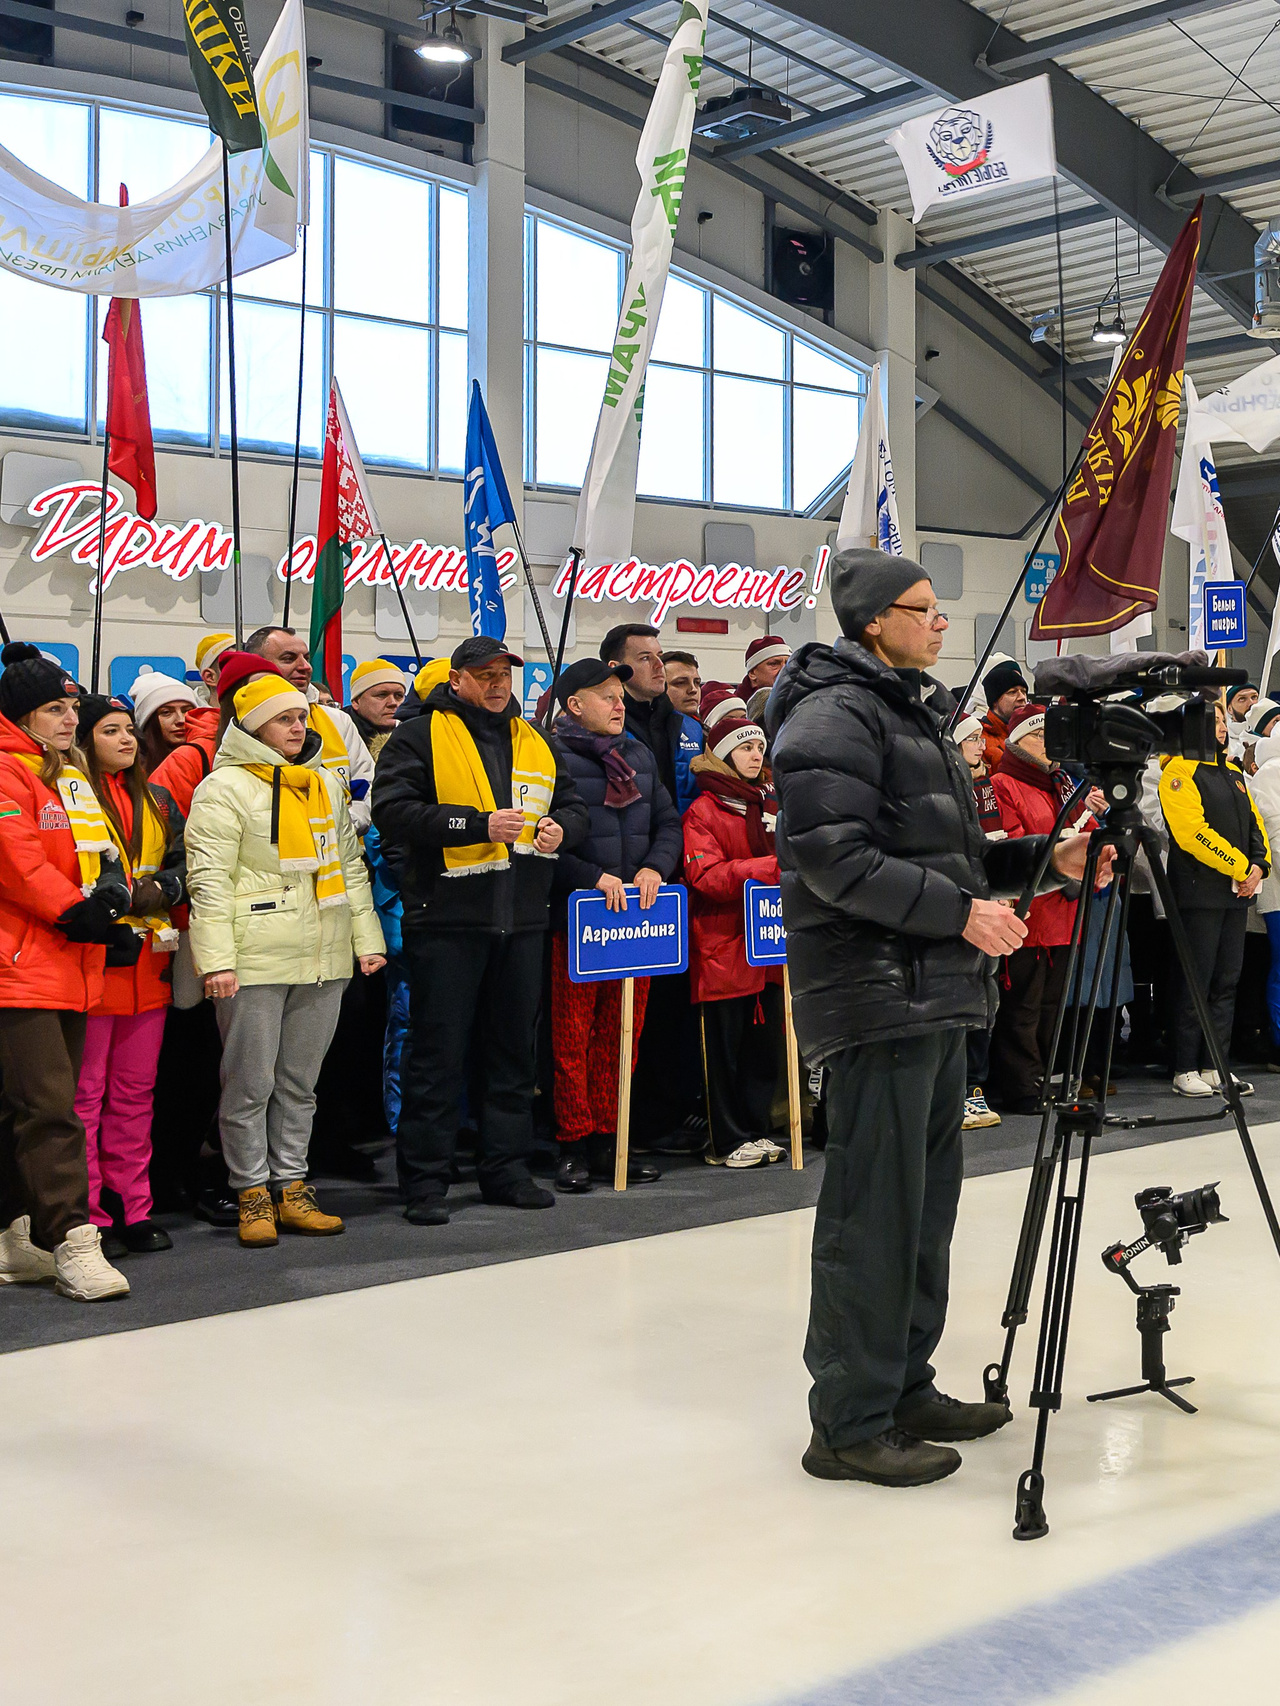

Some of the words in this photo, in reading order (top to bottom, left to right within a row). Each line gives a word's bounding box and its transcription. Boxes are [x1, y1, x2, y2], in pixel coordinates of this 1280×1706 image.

[30, 482, 234, 591] Дарим
[554, 546, 829, 627] настроение!
[1212, 594, 1236, 613] Белые
[1211, 616, 1238, 636] тигры
[1194, 831, 1238, 867] BELARUS
[581, 920, 676, 947] Агрохолдинг
[1120, 1237, 1150, 1261] RONIN
